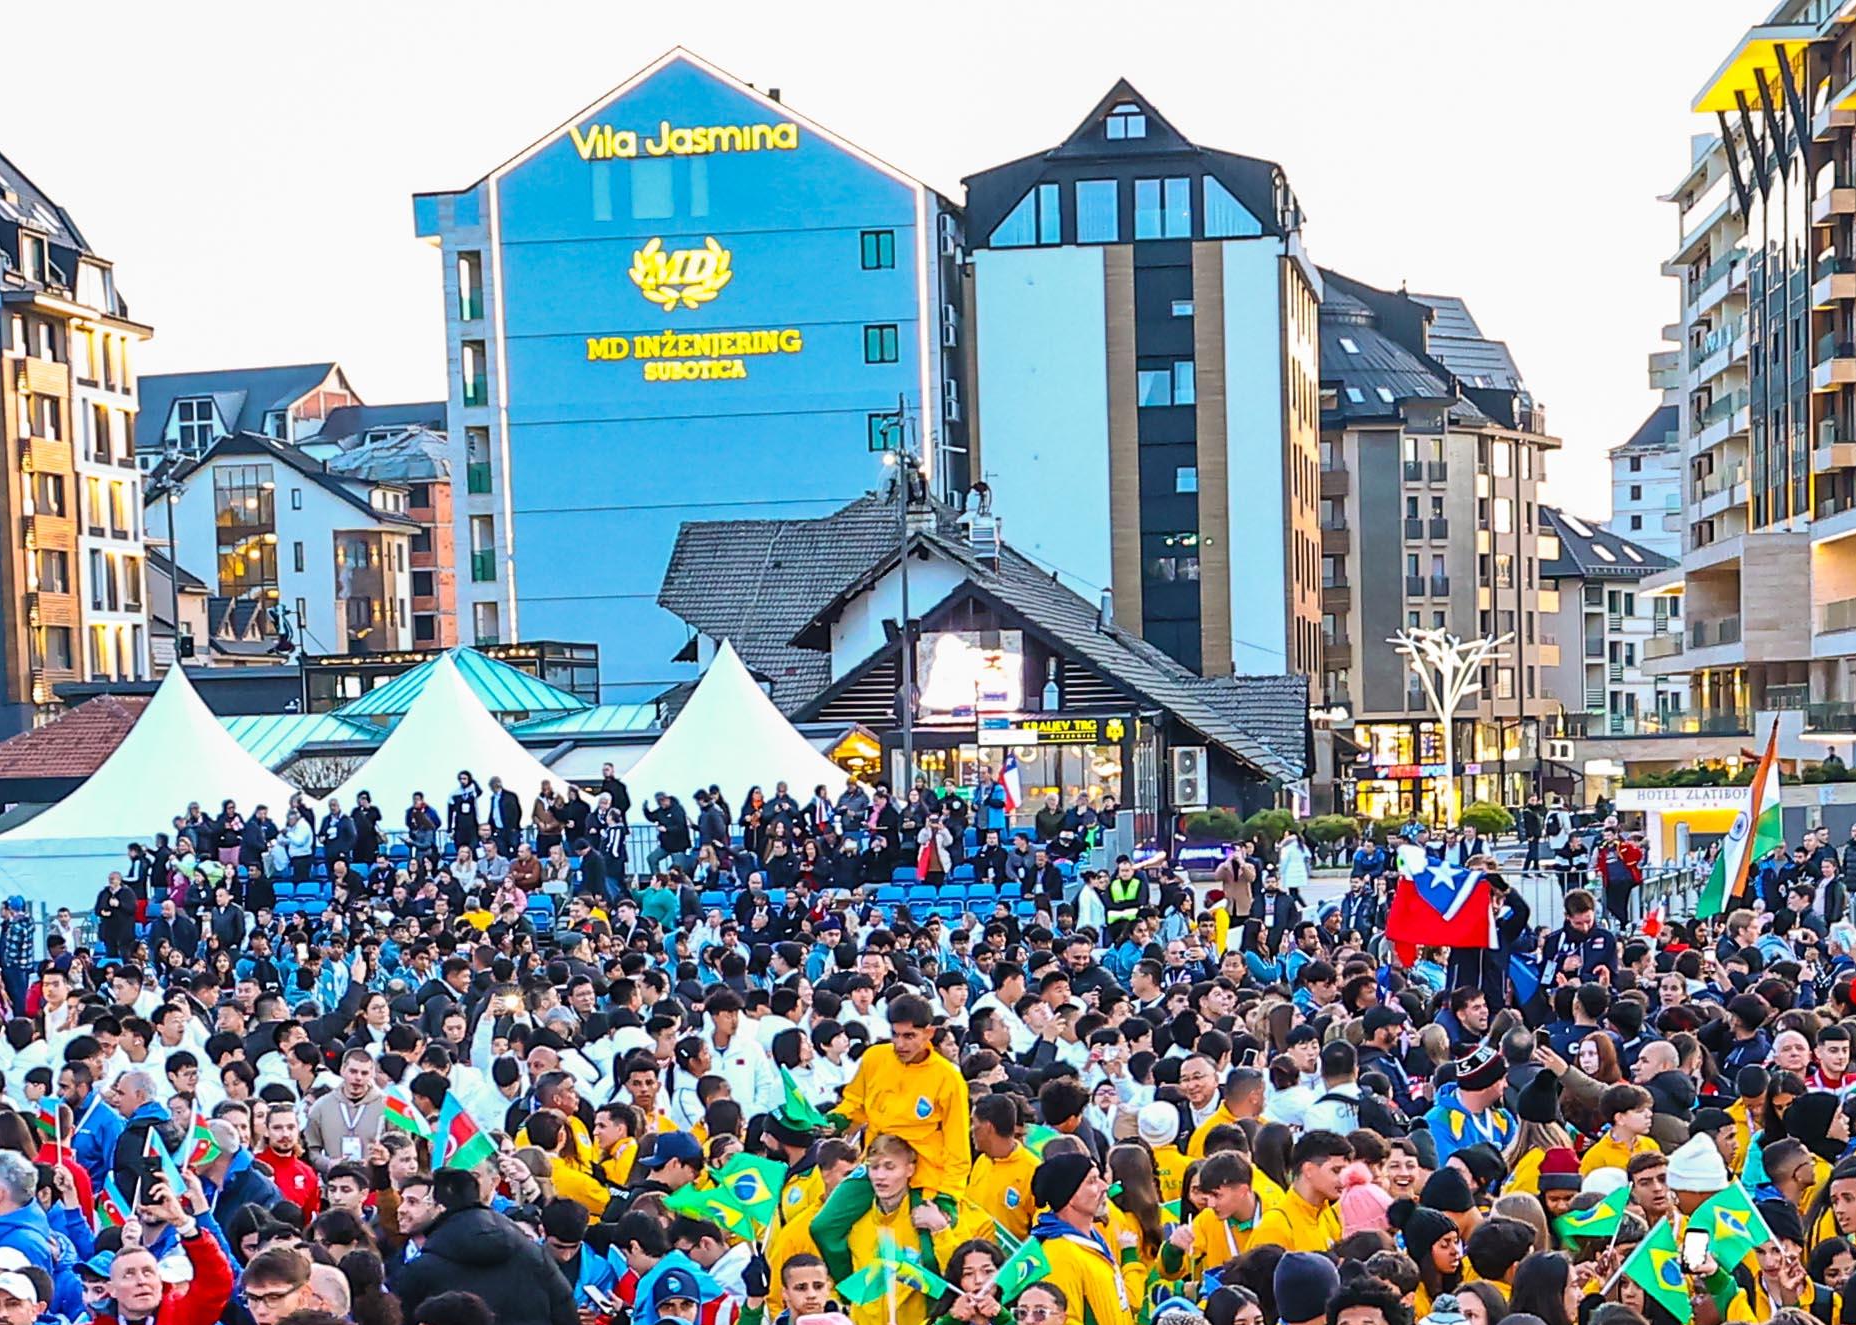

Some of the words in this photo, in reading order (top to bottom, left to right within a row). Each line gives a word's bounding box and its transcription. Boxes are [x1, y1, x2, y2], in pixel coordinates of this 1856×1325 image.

[570, 123, 637, 160] Vila
[646, 120, 798, 156] Jasmina
[587, 337, 629, 360] MD
[634, 329, 803, 359] INŽENJERING
[644, 360, 747, 382] SUBOTICA
[1022, 719, 1071, 732] KRALJEV
[1074, 719, 1098, 732] TRG
[1637, 789, 1680, 801] HOTEL
